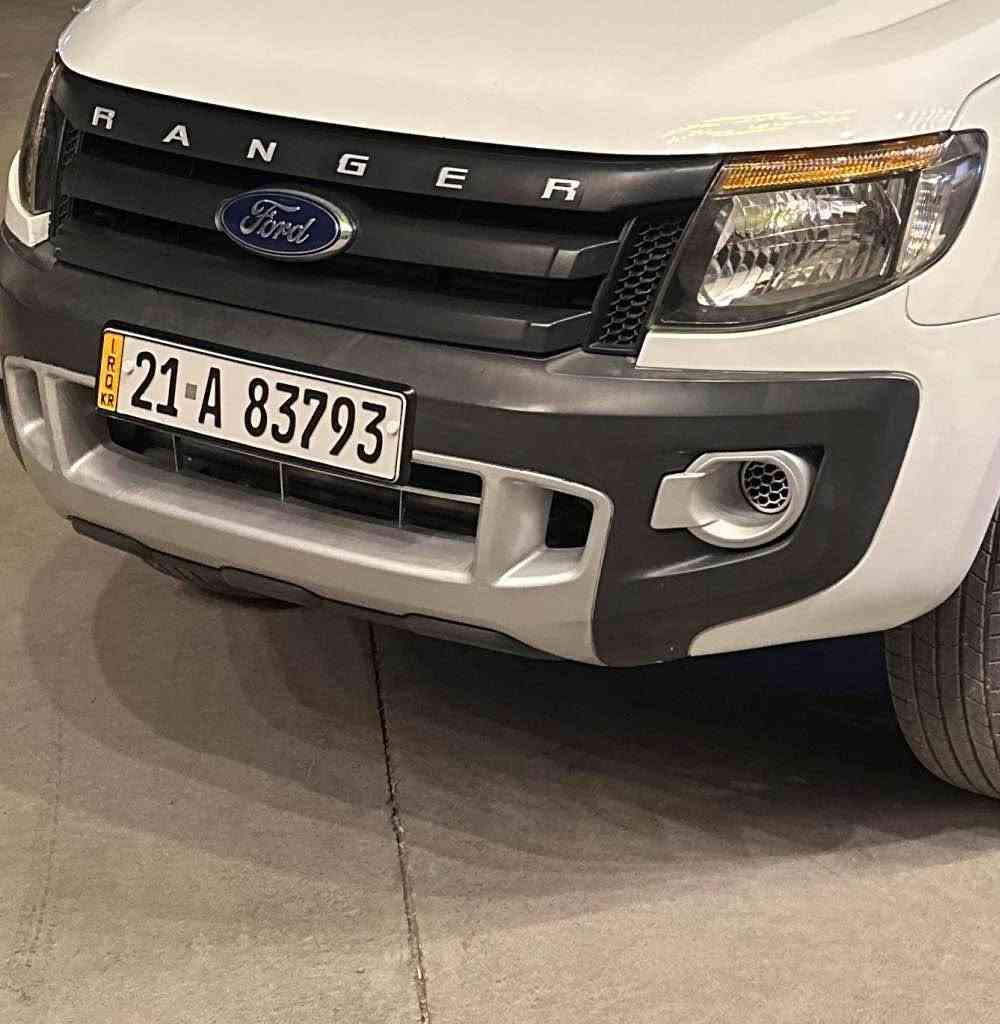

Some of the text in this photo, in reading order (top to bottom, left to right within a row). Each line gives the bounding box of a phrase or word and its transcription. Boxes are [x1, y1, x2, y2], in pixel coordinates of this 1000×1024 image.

[91, 105, 580, 202] RANGER
[239, 199, 316, 244] Ford
[100, 393, 115, 409] KR
[244, 375, 387, 464] 83793
